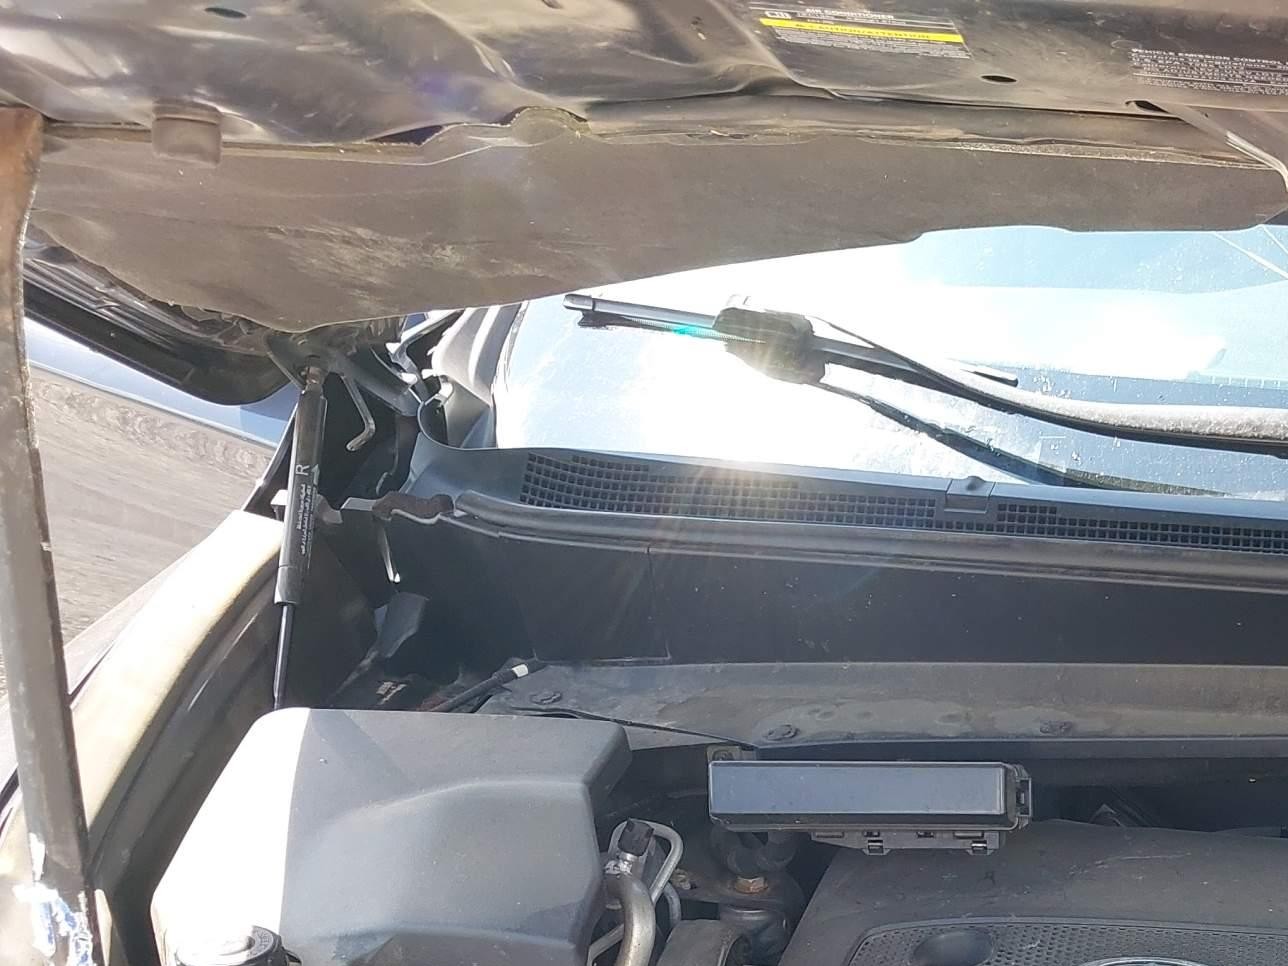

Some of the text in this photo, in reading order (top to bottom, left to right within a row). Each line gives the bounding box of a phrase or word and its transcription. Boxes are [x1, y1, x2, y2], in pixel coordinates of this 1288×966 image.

[1131, 48, 1175, 56] VEHICLE
[1178, 52, 1230, 60] EMISSION
[1234, 56, 1281, 65] CONTROL
